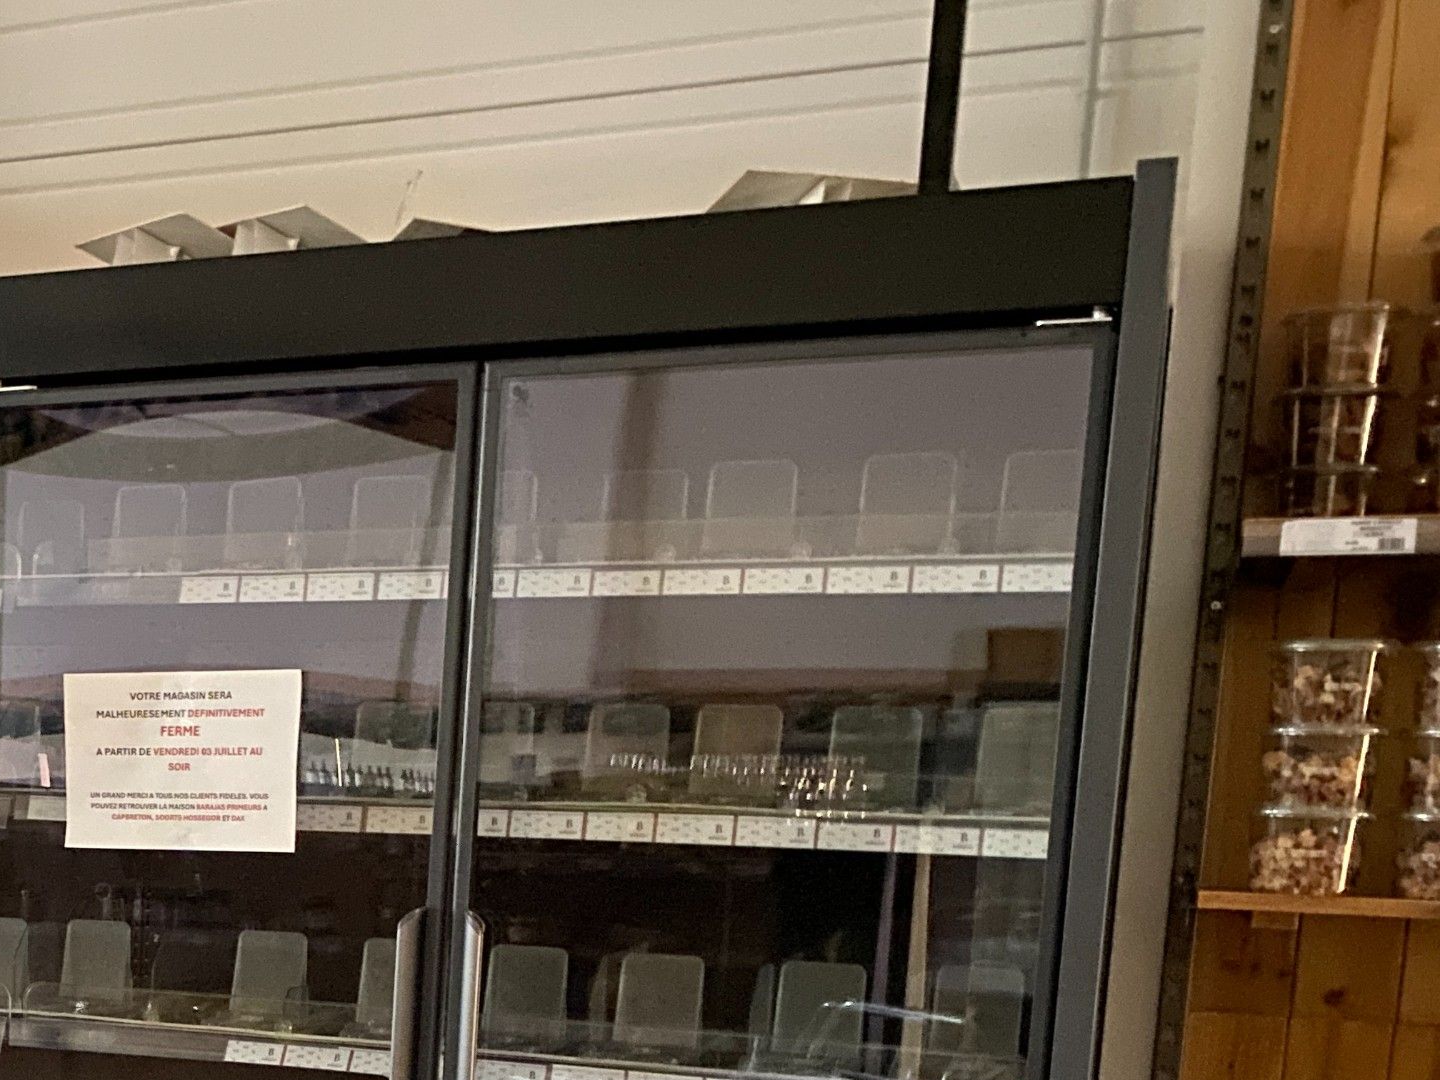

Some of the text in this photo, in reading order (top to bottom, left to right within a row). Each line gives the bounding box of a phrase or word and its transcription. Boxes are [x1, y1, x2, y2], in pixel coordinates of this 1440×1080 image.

[129, 691, 232, 701] VOTRE MAGASIN SERA
[187, 708, 265, 717] DEFINITIVEMENT
[160, 726, 201, 737] FERME
[96, 748, 103, 756] A
[104, 748, 137, 756] PARTIR
[139, 748, 152, 756] DE
[153, 747, 199, 756] VENDREDI
[213, 747, 248, 756] JUILLET
[249, 747, 263, 756] AU
[168, 763, 191, 771] SOIR
